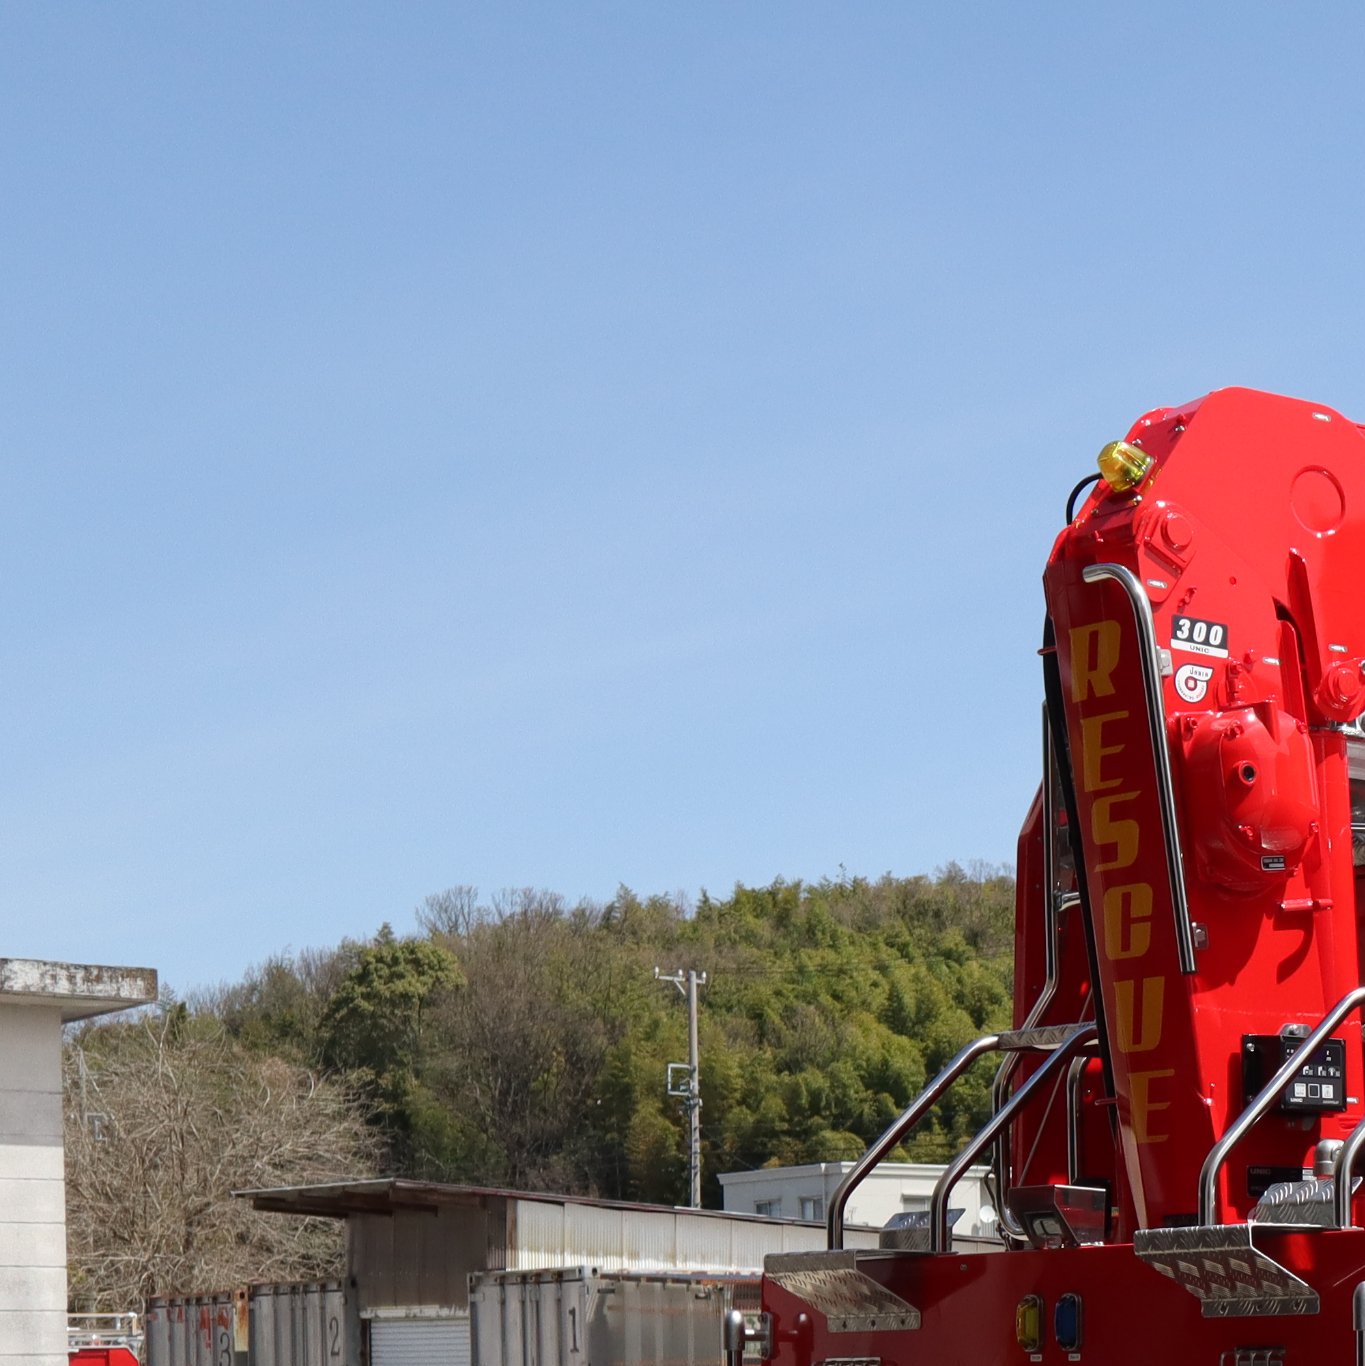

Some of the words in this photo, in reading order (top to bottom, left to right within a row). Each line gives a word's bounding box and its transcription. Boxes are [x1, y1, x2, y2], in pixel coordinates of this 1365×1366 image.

[1176, 618, 1223, 646] 300
[1189, 645, 1210, 654] UNIC
[1068, 619, 1176, 1144] RESCUE
[329, 1316, 340, 1356] 2
[569, 1306, 579, 1353] 1
